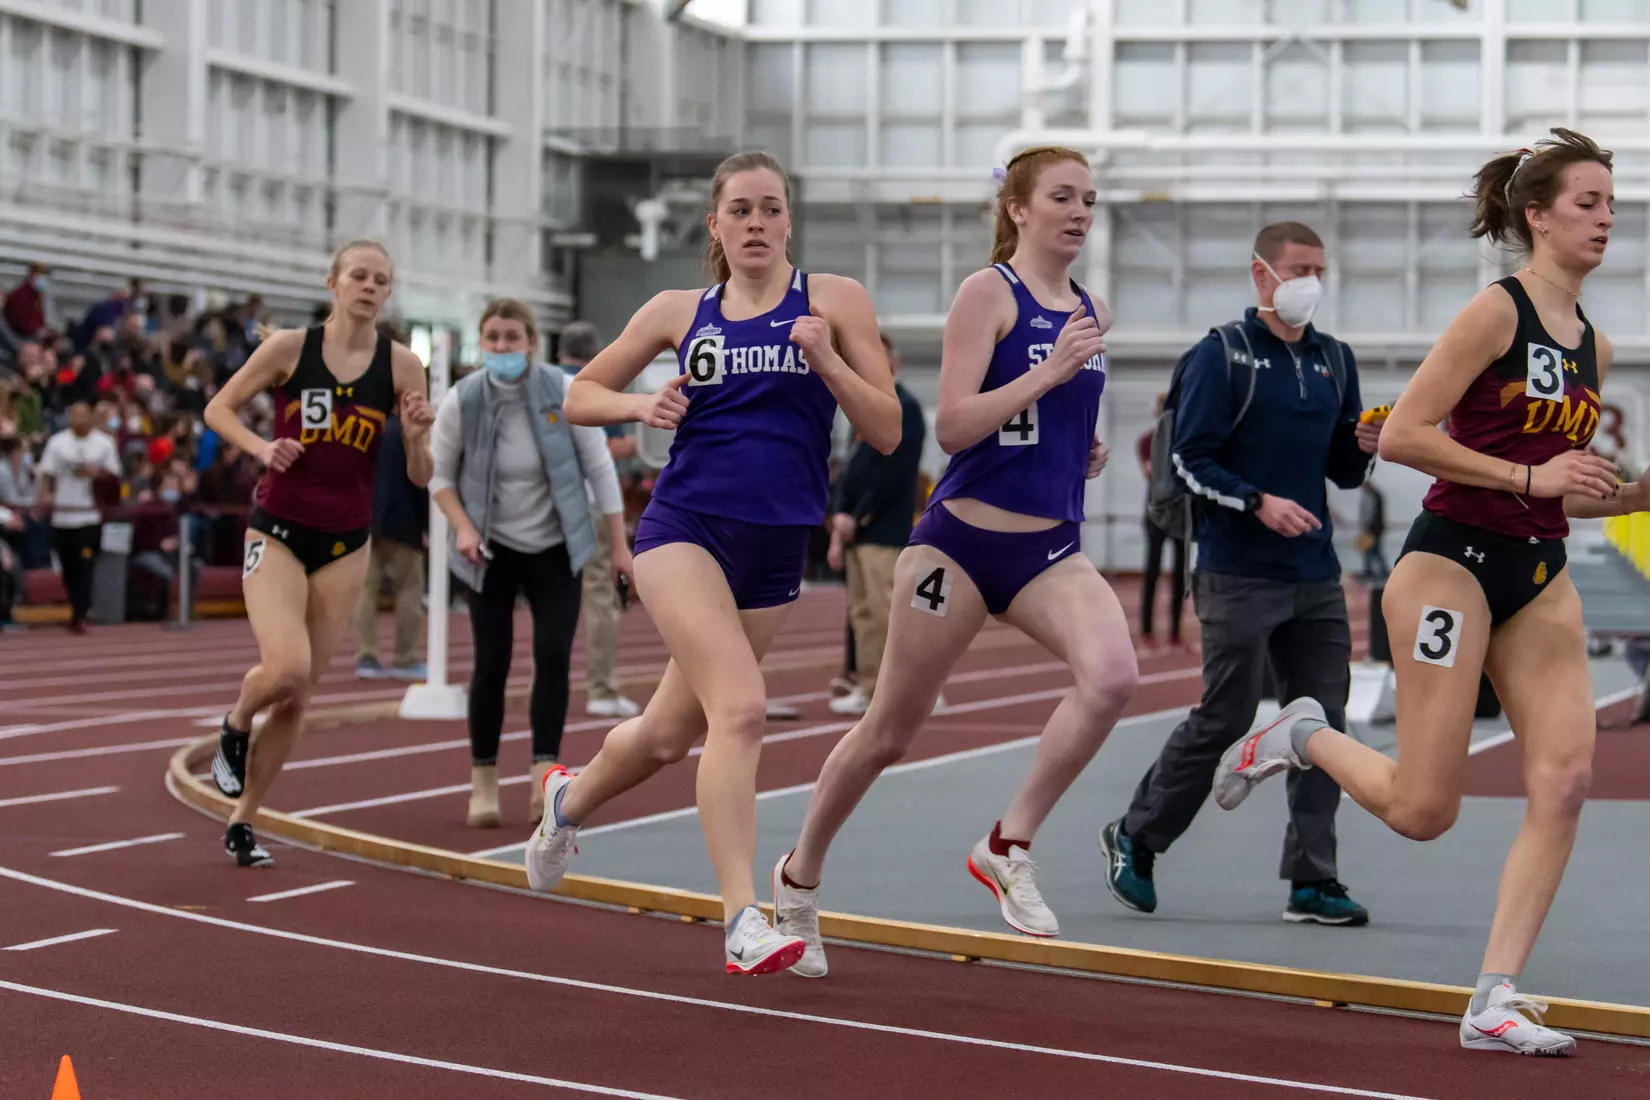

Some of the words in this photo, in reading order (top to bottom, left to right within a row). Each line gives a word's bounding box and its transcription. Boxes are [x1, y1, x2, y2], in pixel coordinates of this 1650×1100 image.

[690, 338, 717, 382] 6
[1531, 347, 1560, 395] 3
[305, 391, 328, 425] 5
[1001, 408, 1034, 441] 4
[1522, 395, 1599, 446] UMD
[245, 540, 263, 572] 5
[916, 567, 945, 611] 4
[1419, 610, 1454, 660] 3
